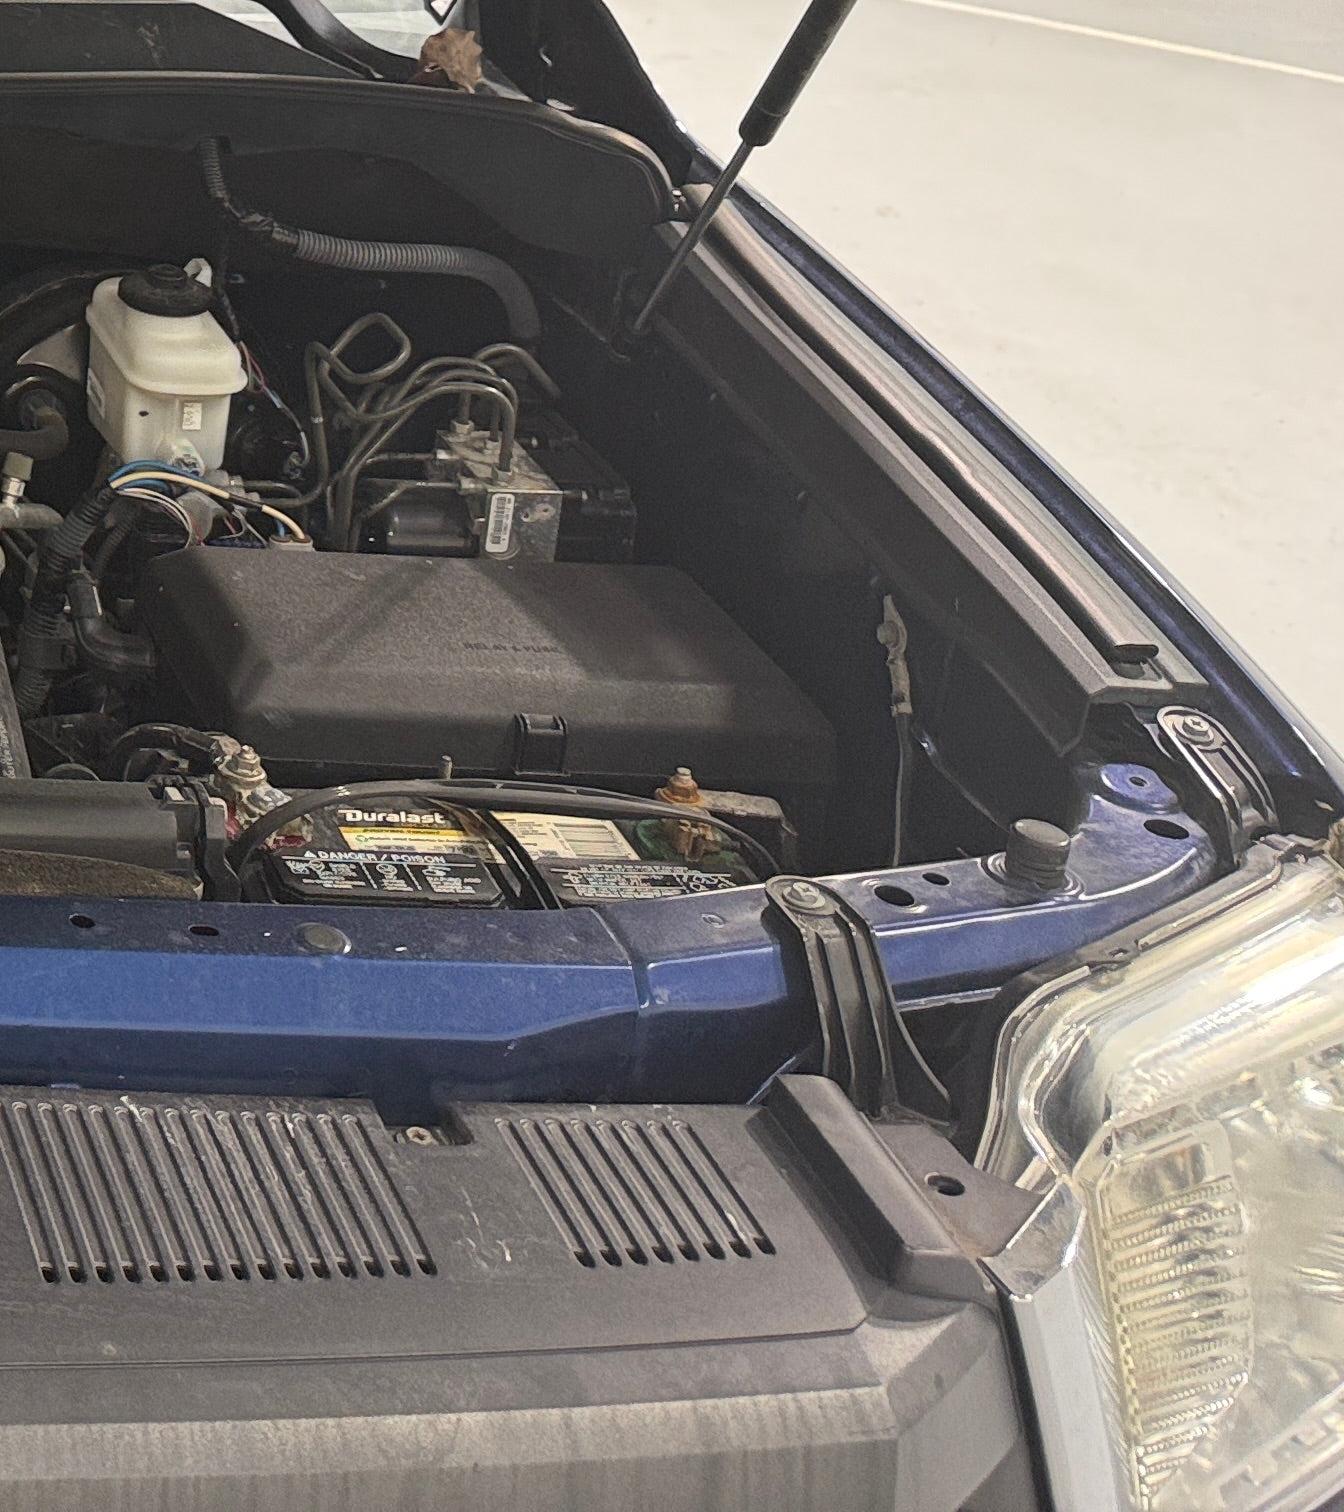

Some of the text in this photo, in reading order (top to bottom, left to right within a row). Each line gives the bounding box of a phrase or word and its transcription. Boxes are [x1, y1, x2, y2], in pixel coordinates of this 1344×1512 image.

[337, 809, 446, 824] Duralast
[317, 851, 382, 862] DANGER
[391, 853, 446, 864] POISON
